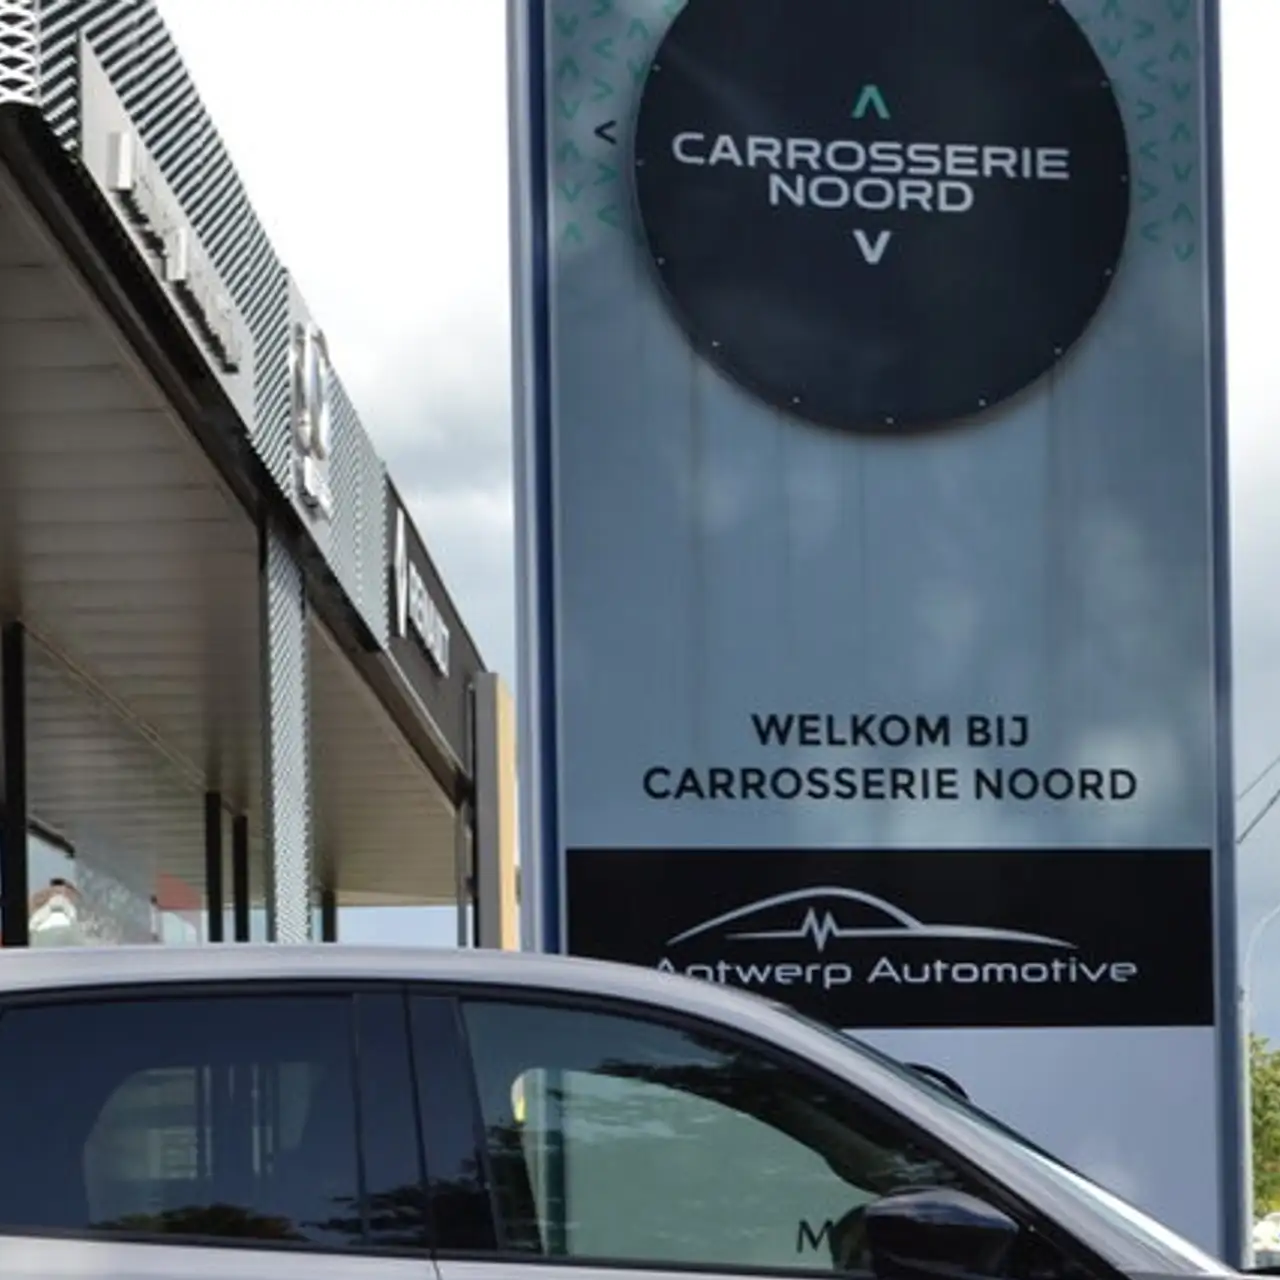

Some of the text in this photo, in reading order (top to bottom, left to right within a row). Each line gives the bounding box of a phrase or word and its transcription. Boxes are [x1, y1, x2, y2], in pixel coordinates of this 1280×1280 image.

[672, 132, 1070, 180] CARROSSERIE
[769, 174, 976, 213] NOORD
[751, 714, 1029, 747] WELKOM BIJ
[643, 766, 1137, 800] CARROSSERIE NOORD
[867, 957, 1138, 985] Automotive
